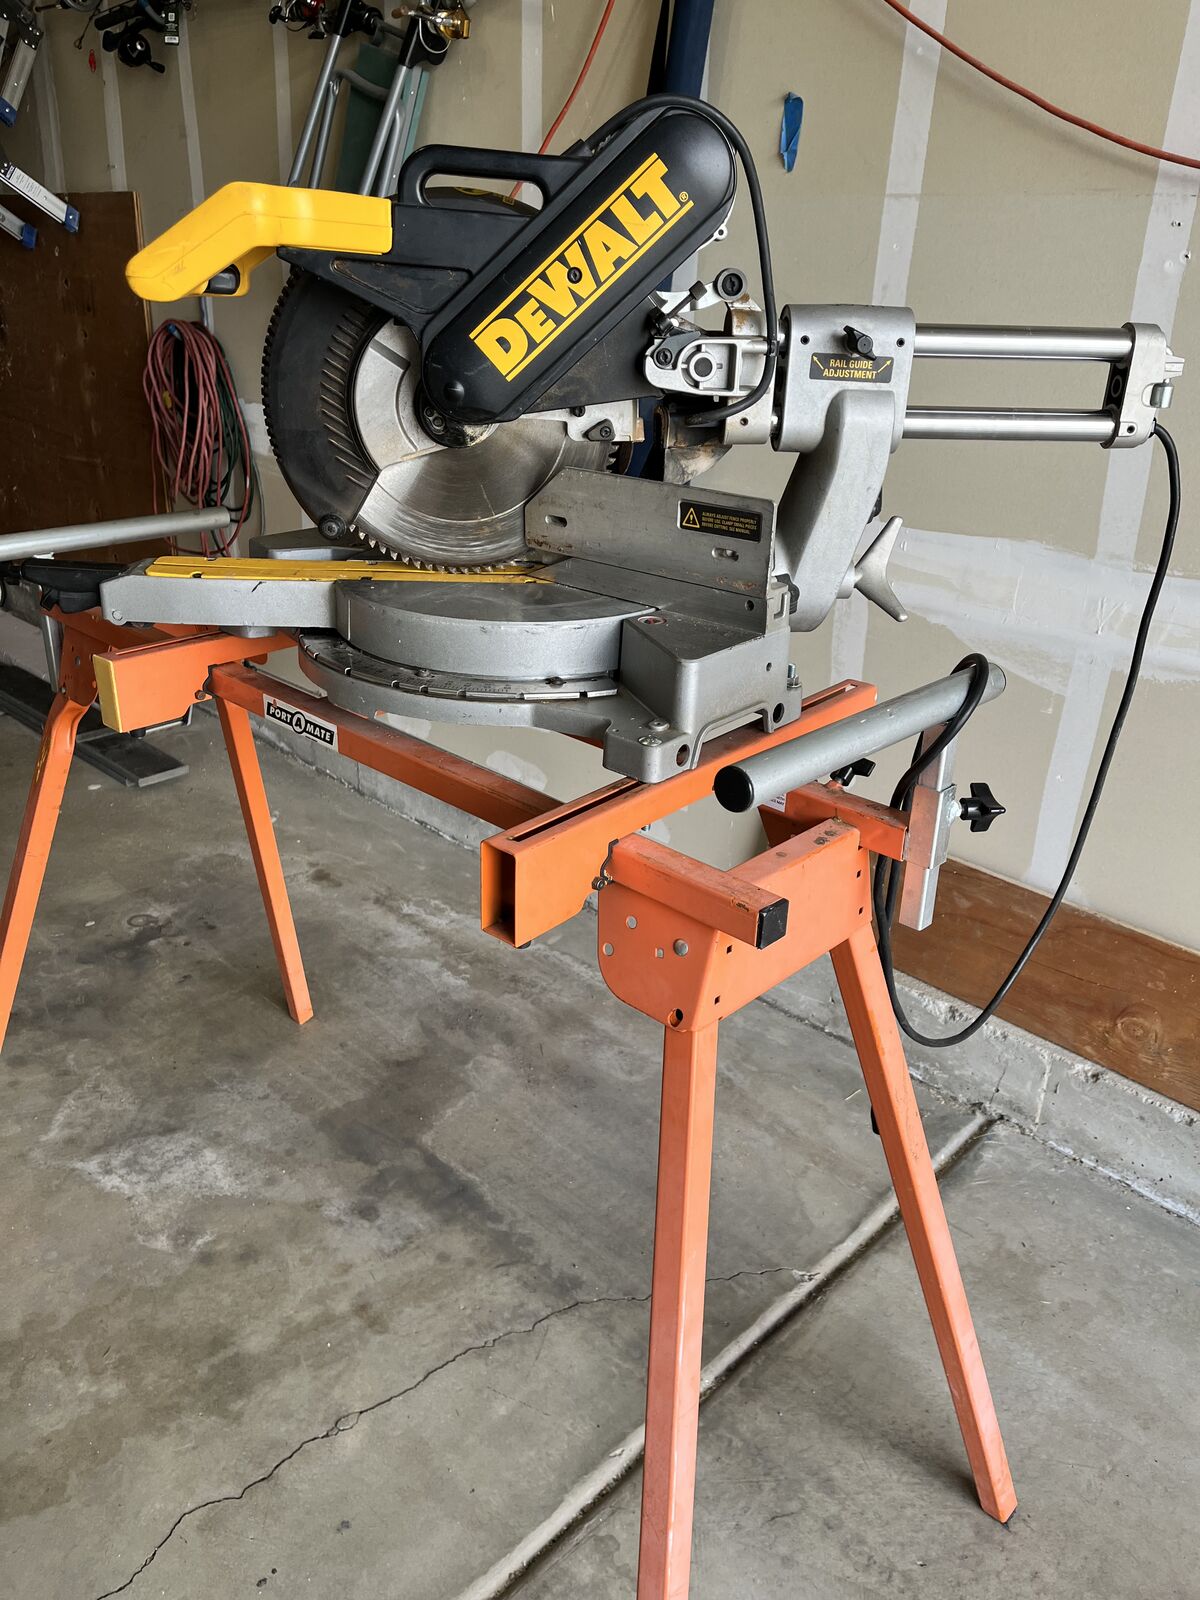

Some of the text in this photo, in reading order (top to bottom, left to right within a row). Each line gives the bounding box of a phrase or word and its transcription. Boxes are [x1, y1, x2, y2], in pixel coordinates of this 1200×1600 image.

[474, 158, 683, 376] DEWALT
[822, 368, 878, 380] ADJUSTMENT
[829, 358, 874, 369] RAIL GUIDE
[269, 705, 292, 723] PORT
[294, 716, 303, 729] A
[305, 722, 331, 742] MATE
